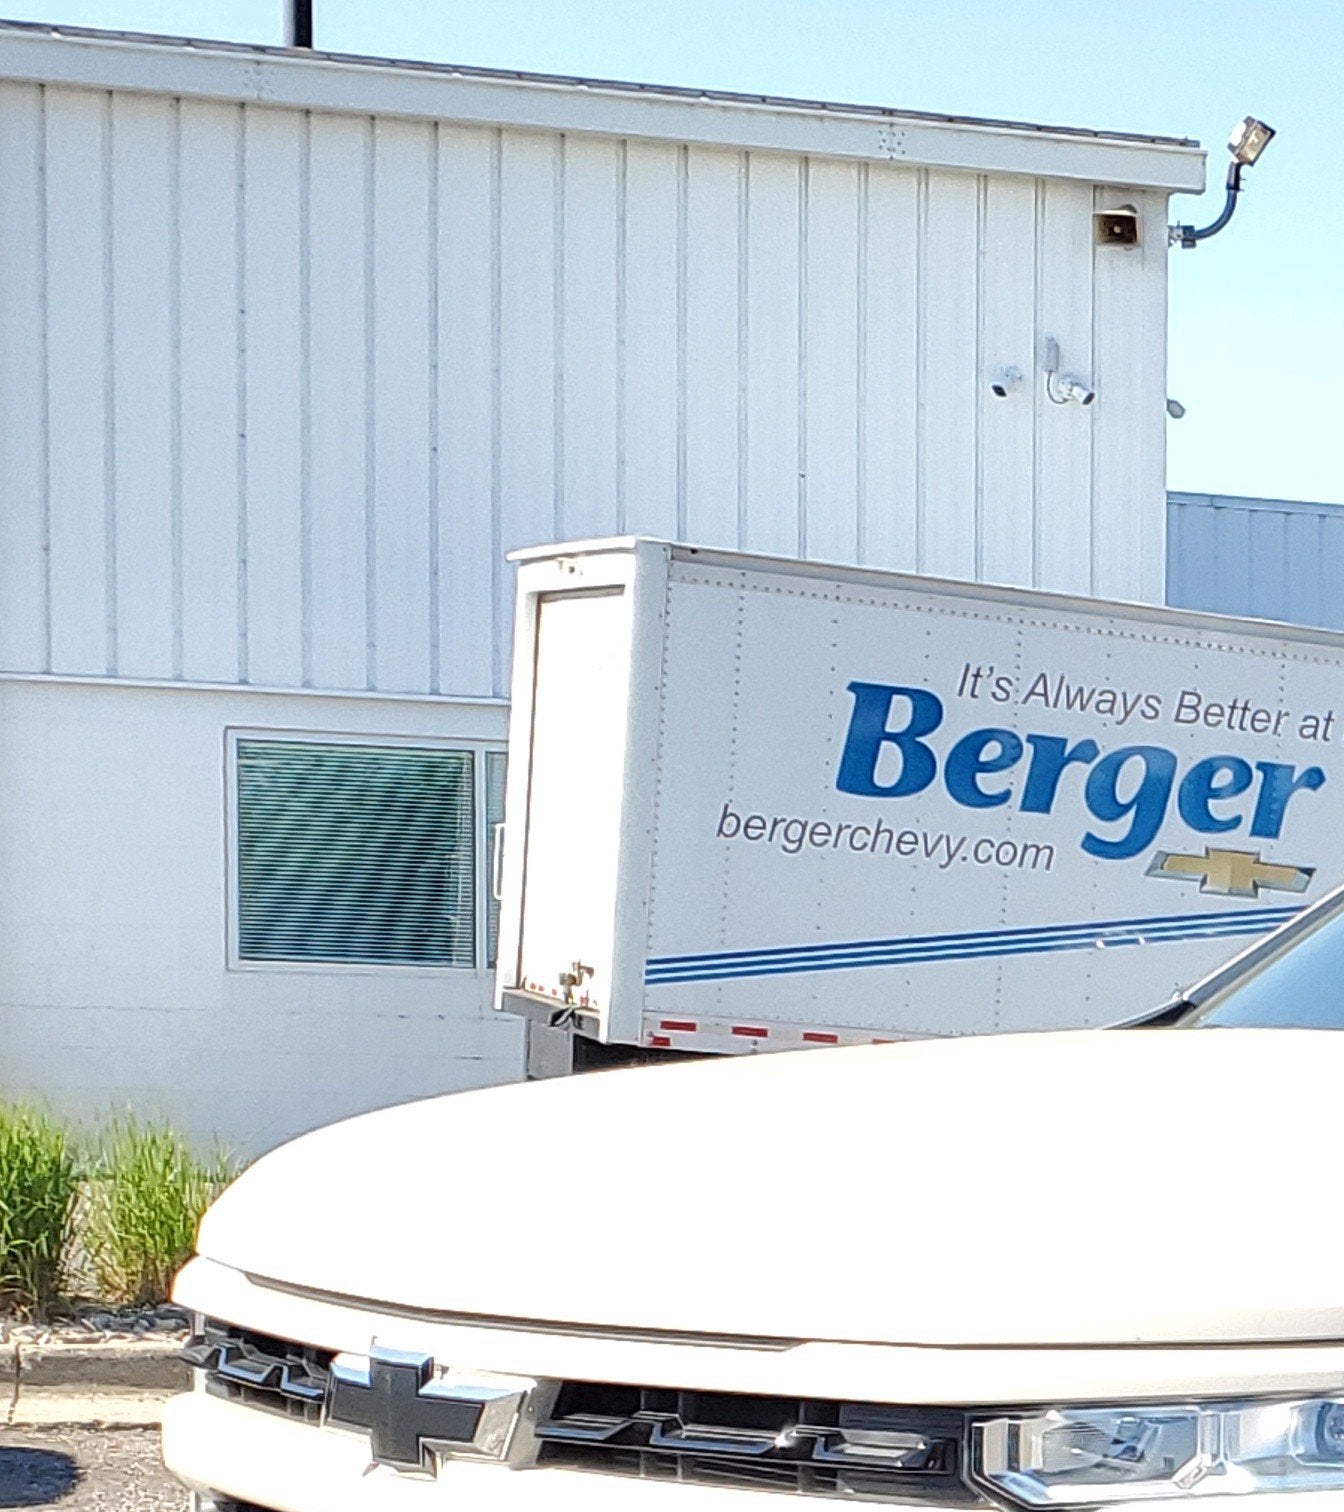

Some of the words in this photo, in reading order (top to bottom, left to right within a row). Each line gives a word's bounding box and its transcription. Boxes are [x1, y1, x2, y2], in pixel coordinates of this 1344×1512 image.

[957, 662, 1014, 703] It's
[1021, 672, 1163, 726] Always
[1173, 690, 1290, 736] Better
[1299, 710, 1335, 742] at
[835, 680, 1327, 861] Berger
[716, 803, 1055, 871] bergerchevy.com
